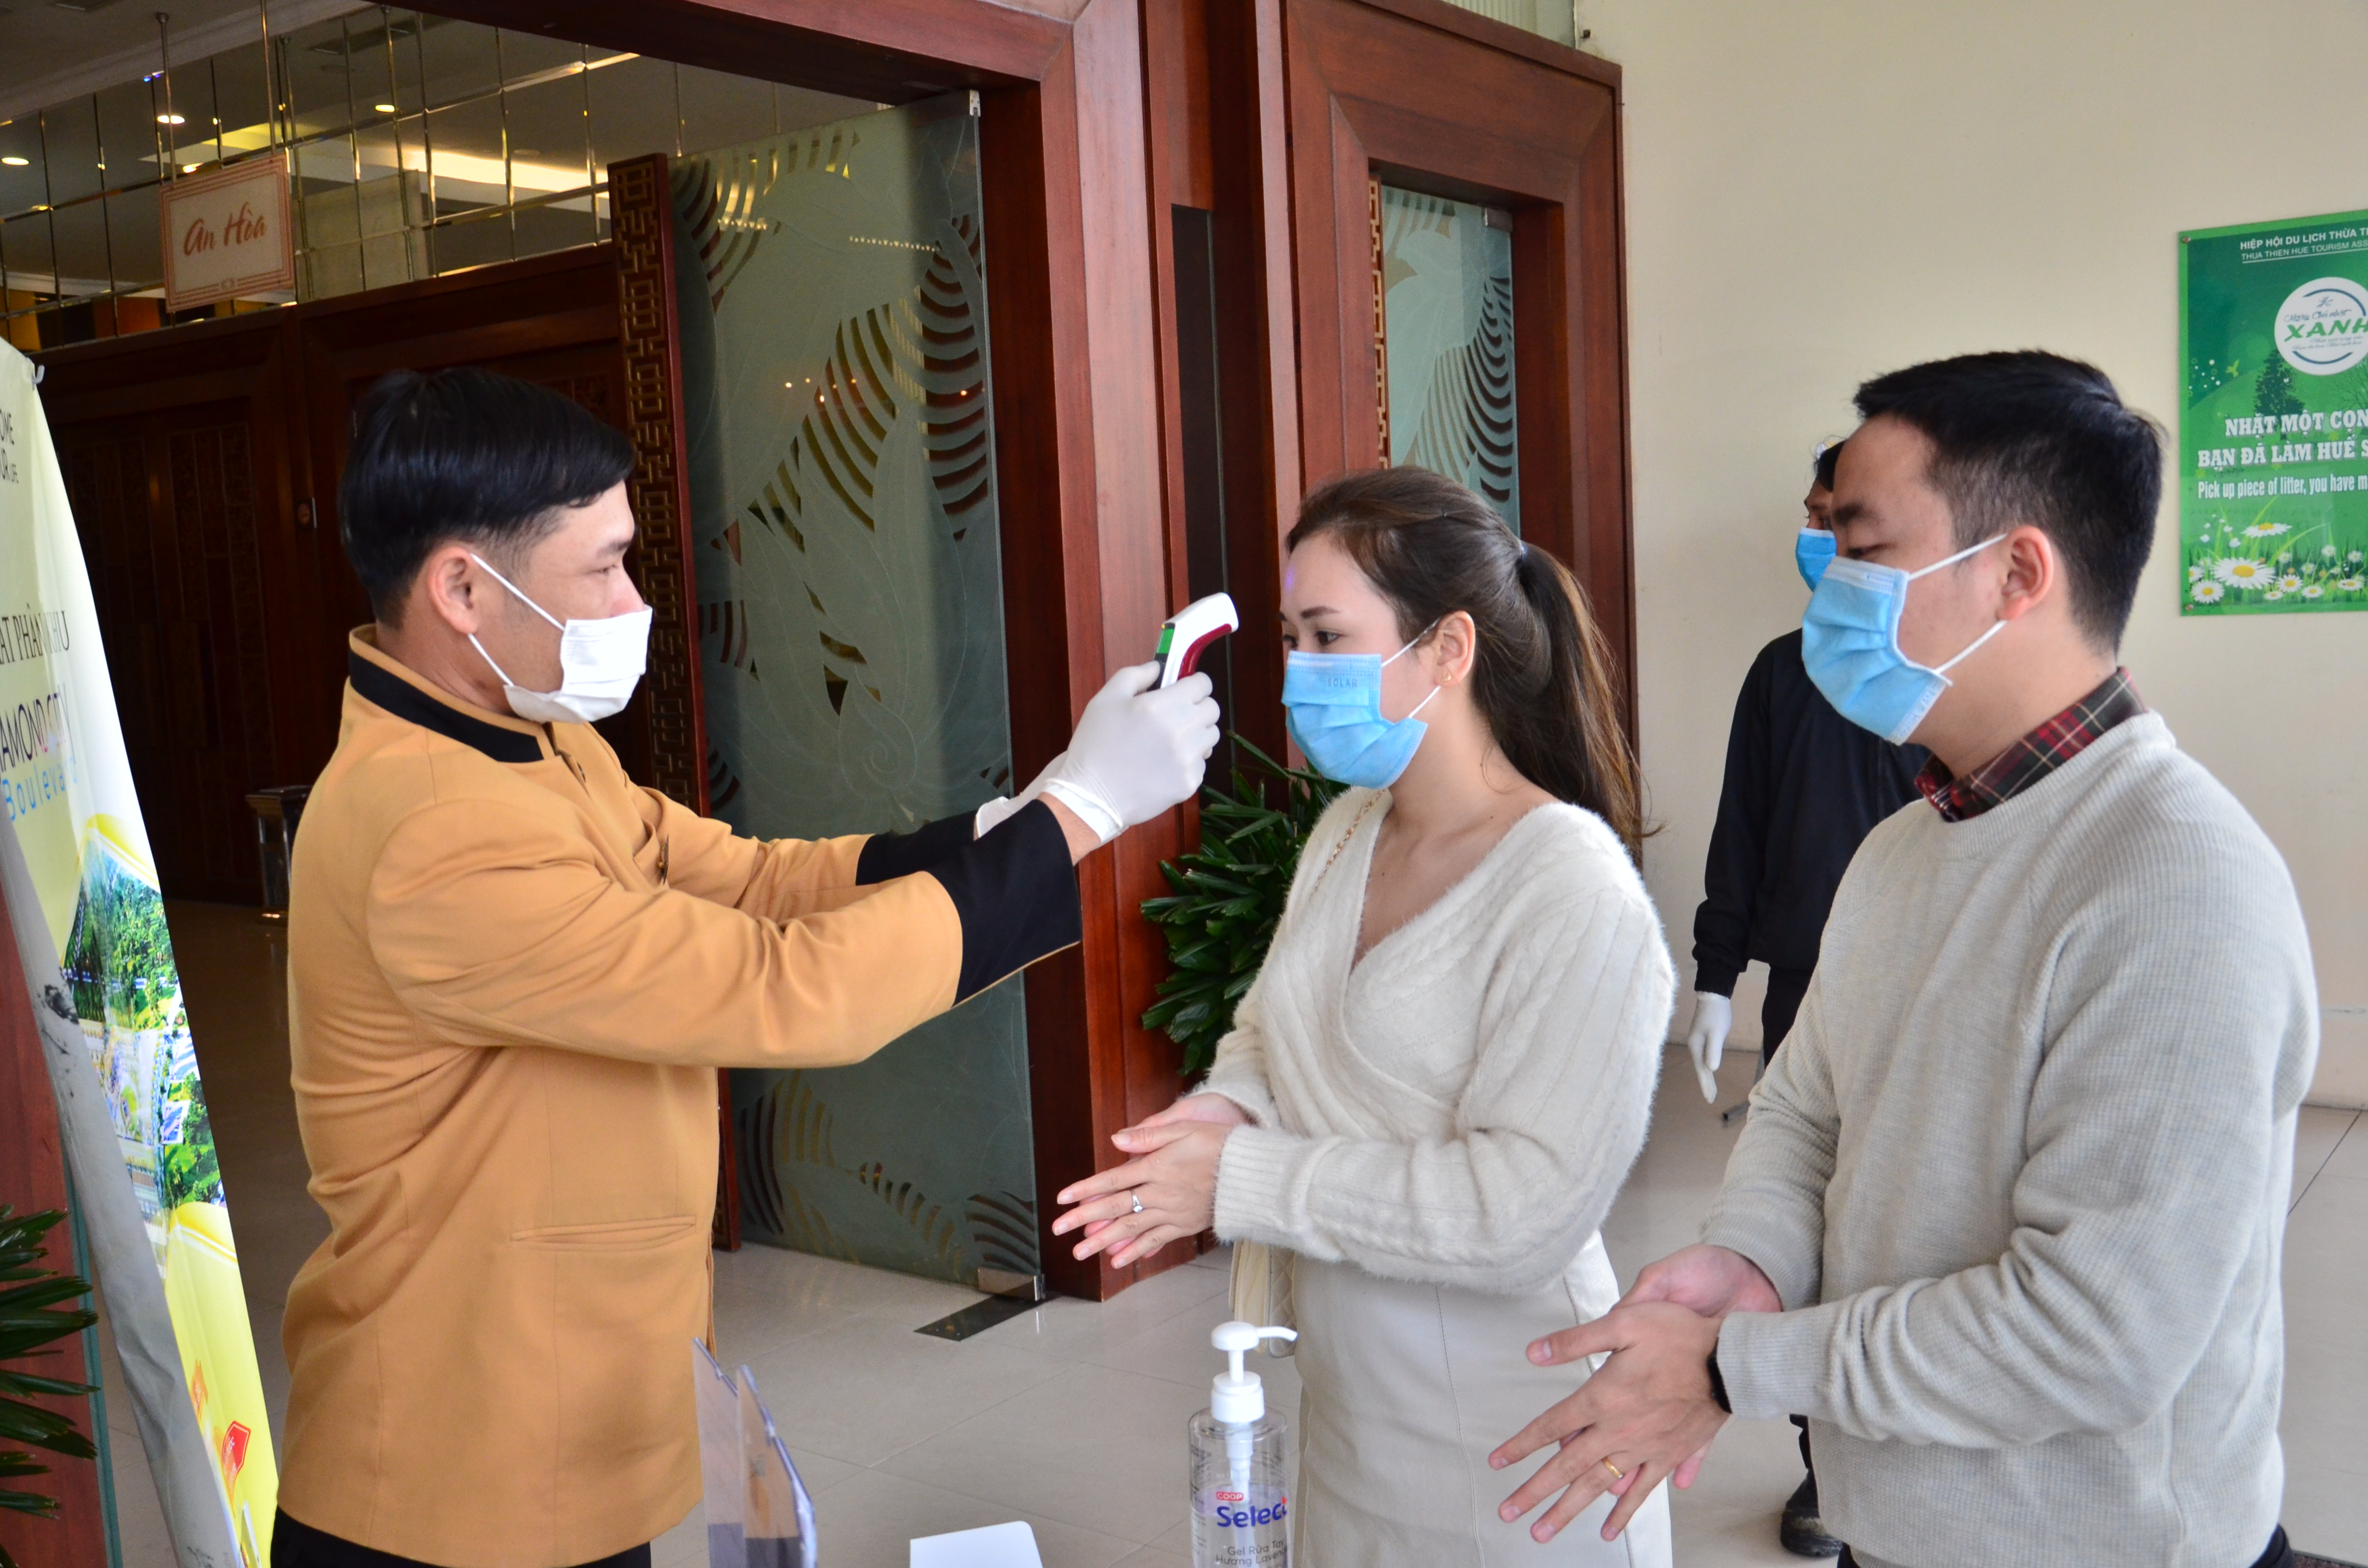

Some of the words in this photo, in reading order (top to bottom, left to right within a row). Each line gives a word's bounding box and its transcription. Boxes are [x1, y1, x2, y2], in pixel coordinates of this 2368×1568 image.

[2240, 239, 2263, 250] HIỆP
[2266, 235, 2282, 247] HỘI
[2285, 235, 2300, 245] DU
[2303, 233, 2326, 244] LỊCH
[2329, 228, 2357, 240] THỪA
[2241, 252, 2263, 261] THUA
[2265, 249, 2289, 258] THIEN
[2291, 246, 2309, 256] HUE
[2311, 242, 2349, 253] TOURISM
[2282, 409, 2324, 436] MỘT
[2198, 448, 2235, 472] BẠN
[2241, 442, 2267, 465] ĐÃ
[2271, 441, 2312, 463] LÀM
[2317, 434, 2356, 460] HUẾ
[2198, 480, 2220, 499] Pick
[2222, 483, 2234, 499] up
[2237, 478, 2265, 499] piece
[2268, 477, 2278, 495] of
[2281, 476, 2306, 495] litter,
[2309, 478, 2327, 495] you
[2331, 474, 2355, 491] have
[1327, 678, 1357, 688] SOLAR
[1217, 1492, 1243, 1500] COOP
[1228, 1546, 1245, 1556] Gel
[1249, 1544, 1269, 1555] Rửa
[1216, 1554, 1252, 1567] Hương
